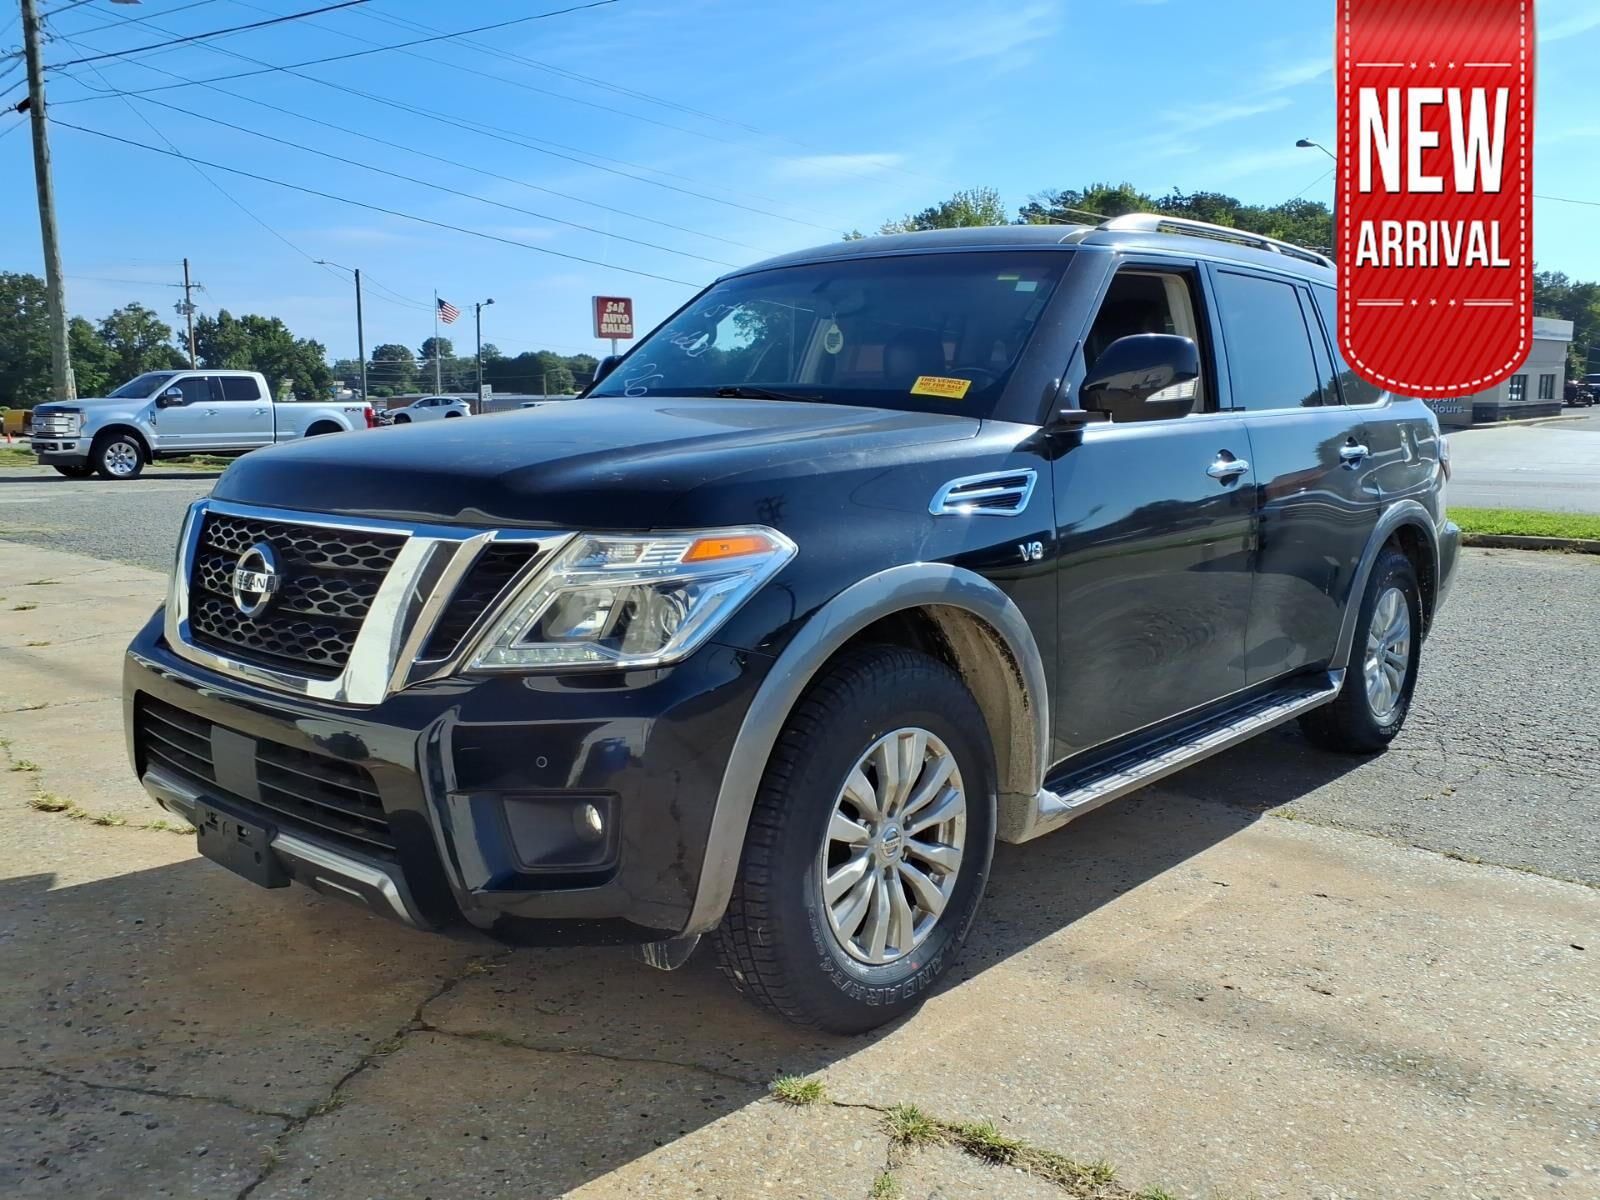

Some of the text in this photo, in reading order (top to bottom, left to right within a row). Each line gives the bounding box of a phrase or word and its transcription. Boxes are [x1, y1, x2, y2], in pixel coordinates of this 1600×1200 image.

[602, 313, 630, 324] AUTO
[600, 323, 632, 334] SALES
[1431, 403, 1465, 414] Hours
[1018, 541, 1044, 561] V8
